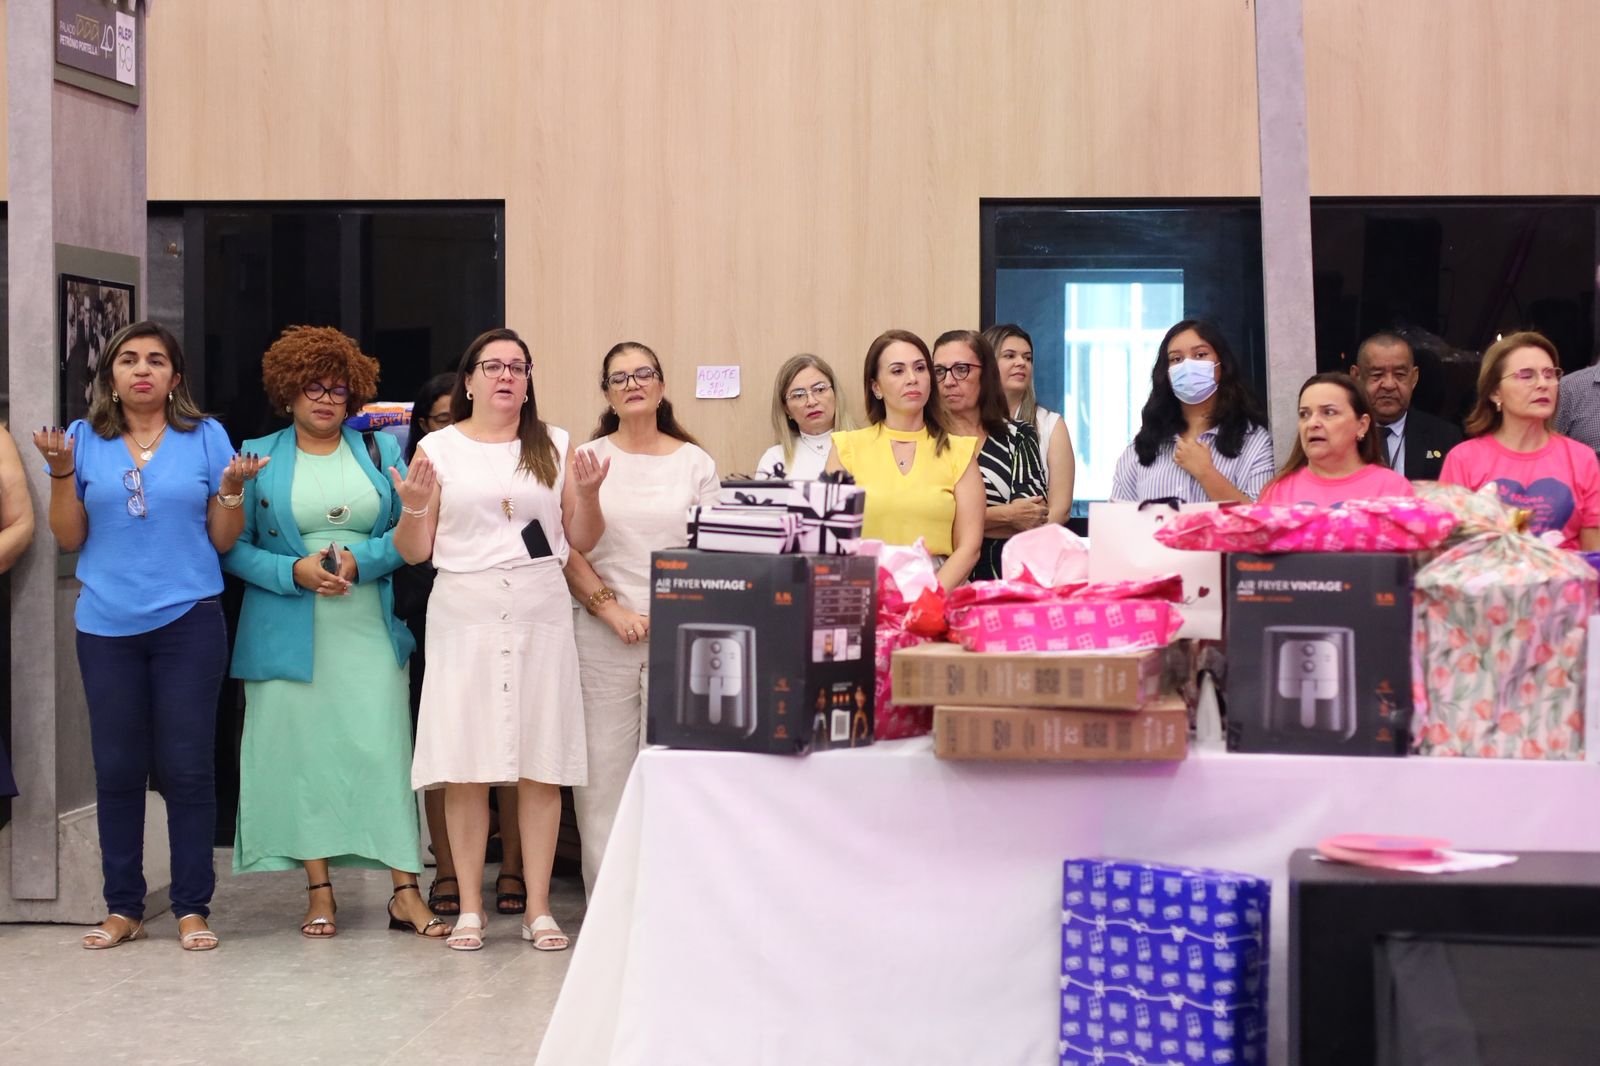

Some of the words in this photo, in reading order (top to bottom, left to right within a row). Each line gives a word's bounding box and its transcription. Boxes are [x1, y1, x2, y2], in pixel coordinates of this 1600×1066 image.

[698, 368, 737, 381] ADOTE
[656, 577, 671, 589] AIR
[673, 577, 700, 590] FRYER
[701, 578, 746, 591] VINTAGE
[1237, 579, 1255, 590] AIR
[1257, 579, 1290, 591] FRYER
[1290, 580, 1343, 592] VINTAGE
[1064, 725, 1079, 745] 32
